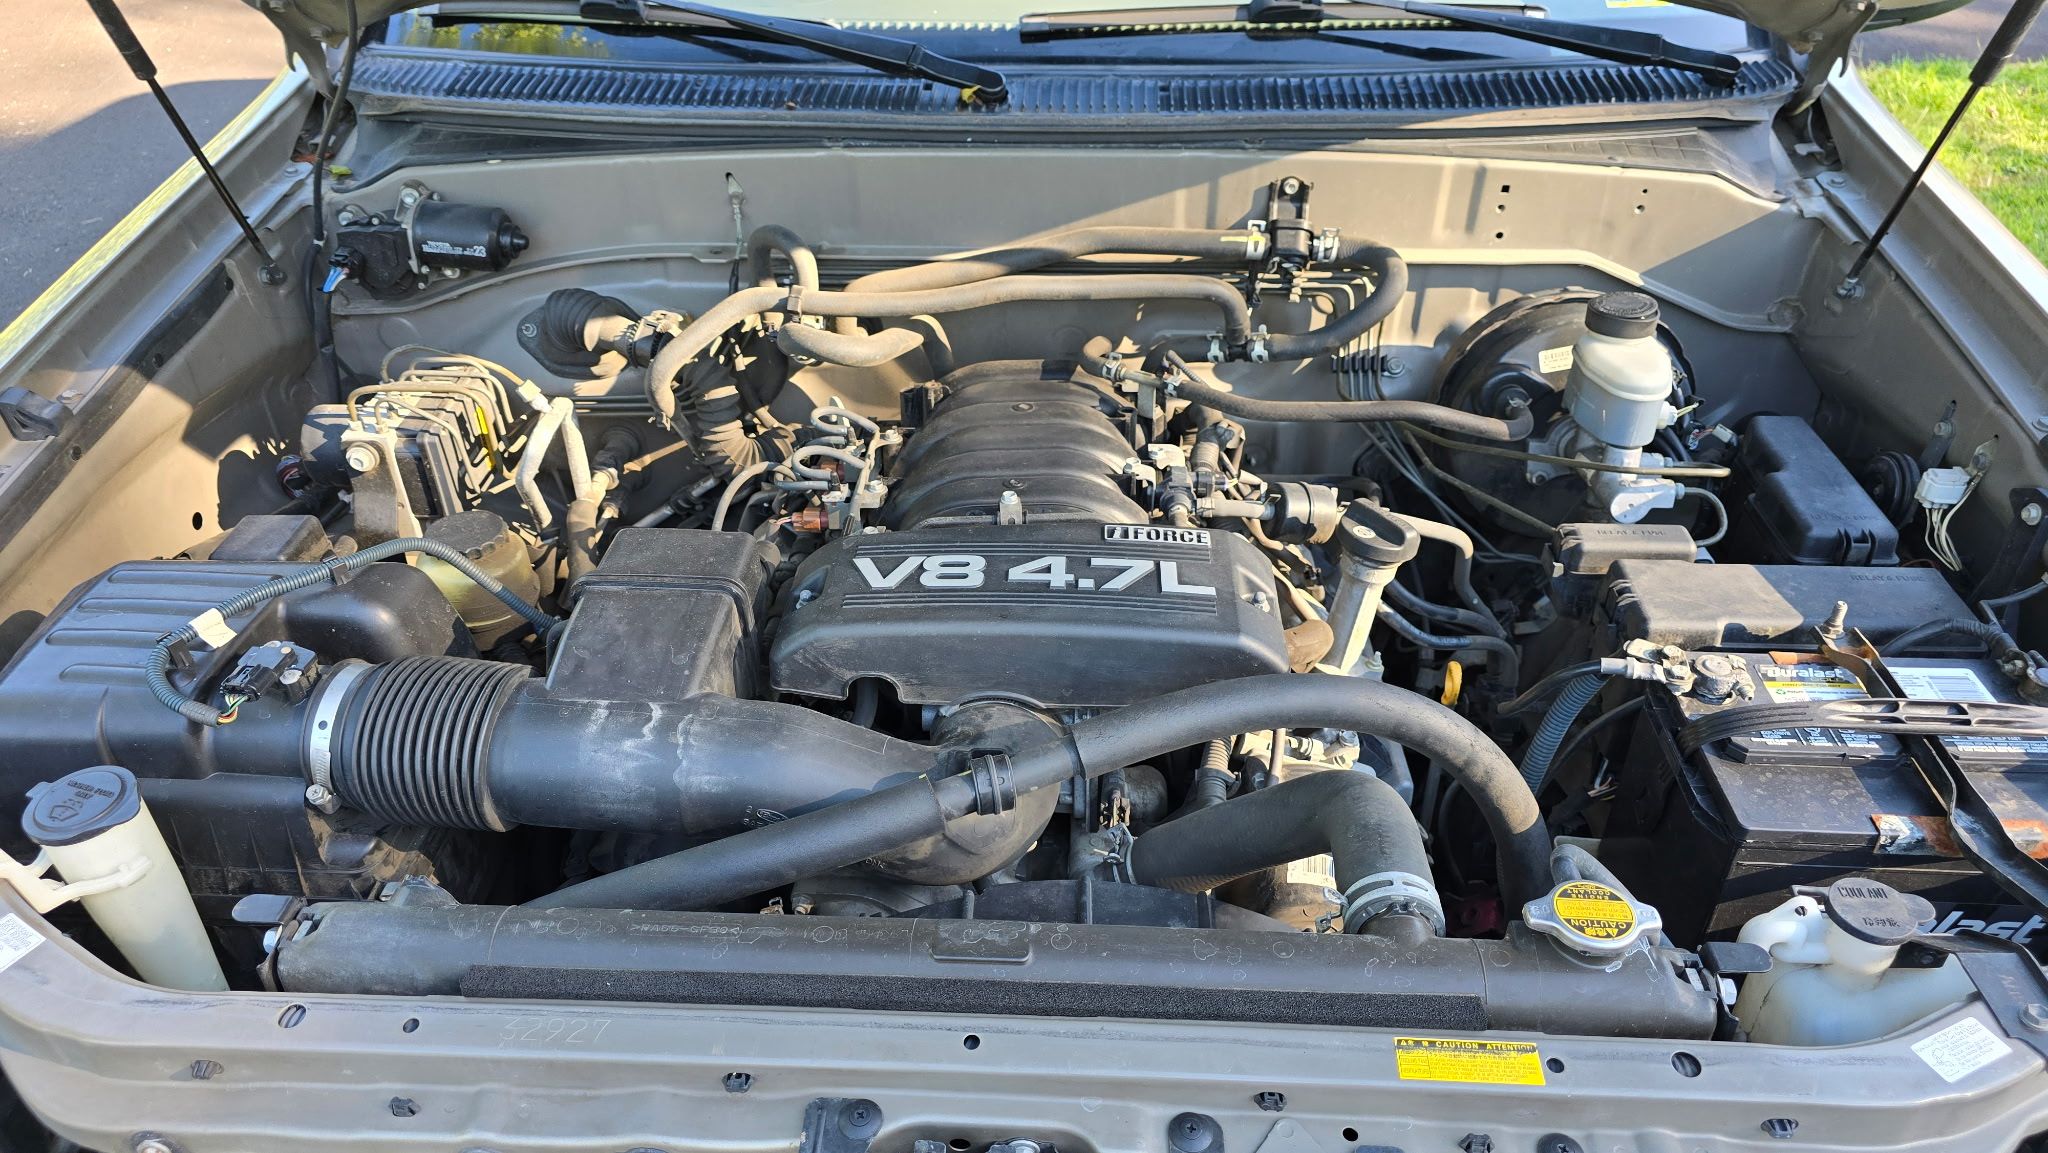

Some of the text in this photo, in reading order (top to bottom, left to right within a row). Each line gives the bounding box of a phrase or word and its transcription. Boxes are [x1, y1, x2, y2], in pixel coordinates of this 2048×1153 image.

[852, 554, 1218, 597] V8 4.7L
[1567, 888, 1611, 896] COOLANT
[1571, 893, 1609, 901] ENGINE
[1571, 919, 1627, 929] CAUTION
[1435, 1040, 1479, 1050] CAUTION
